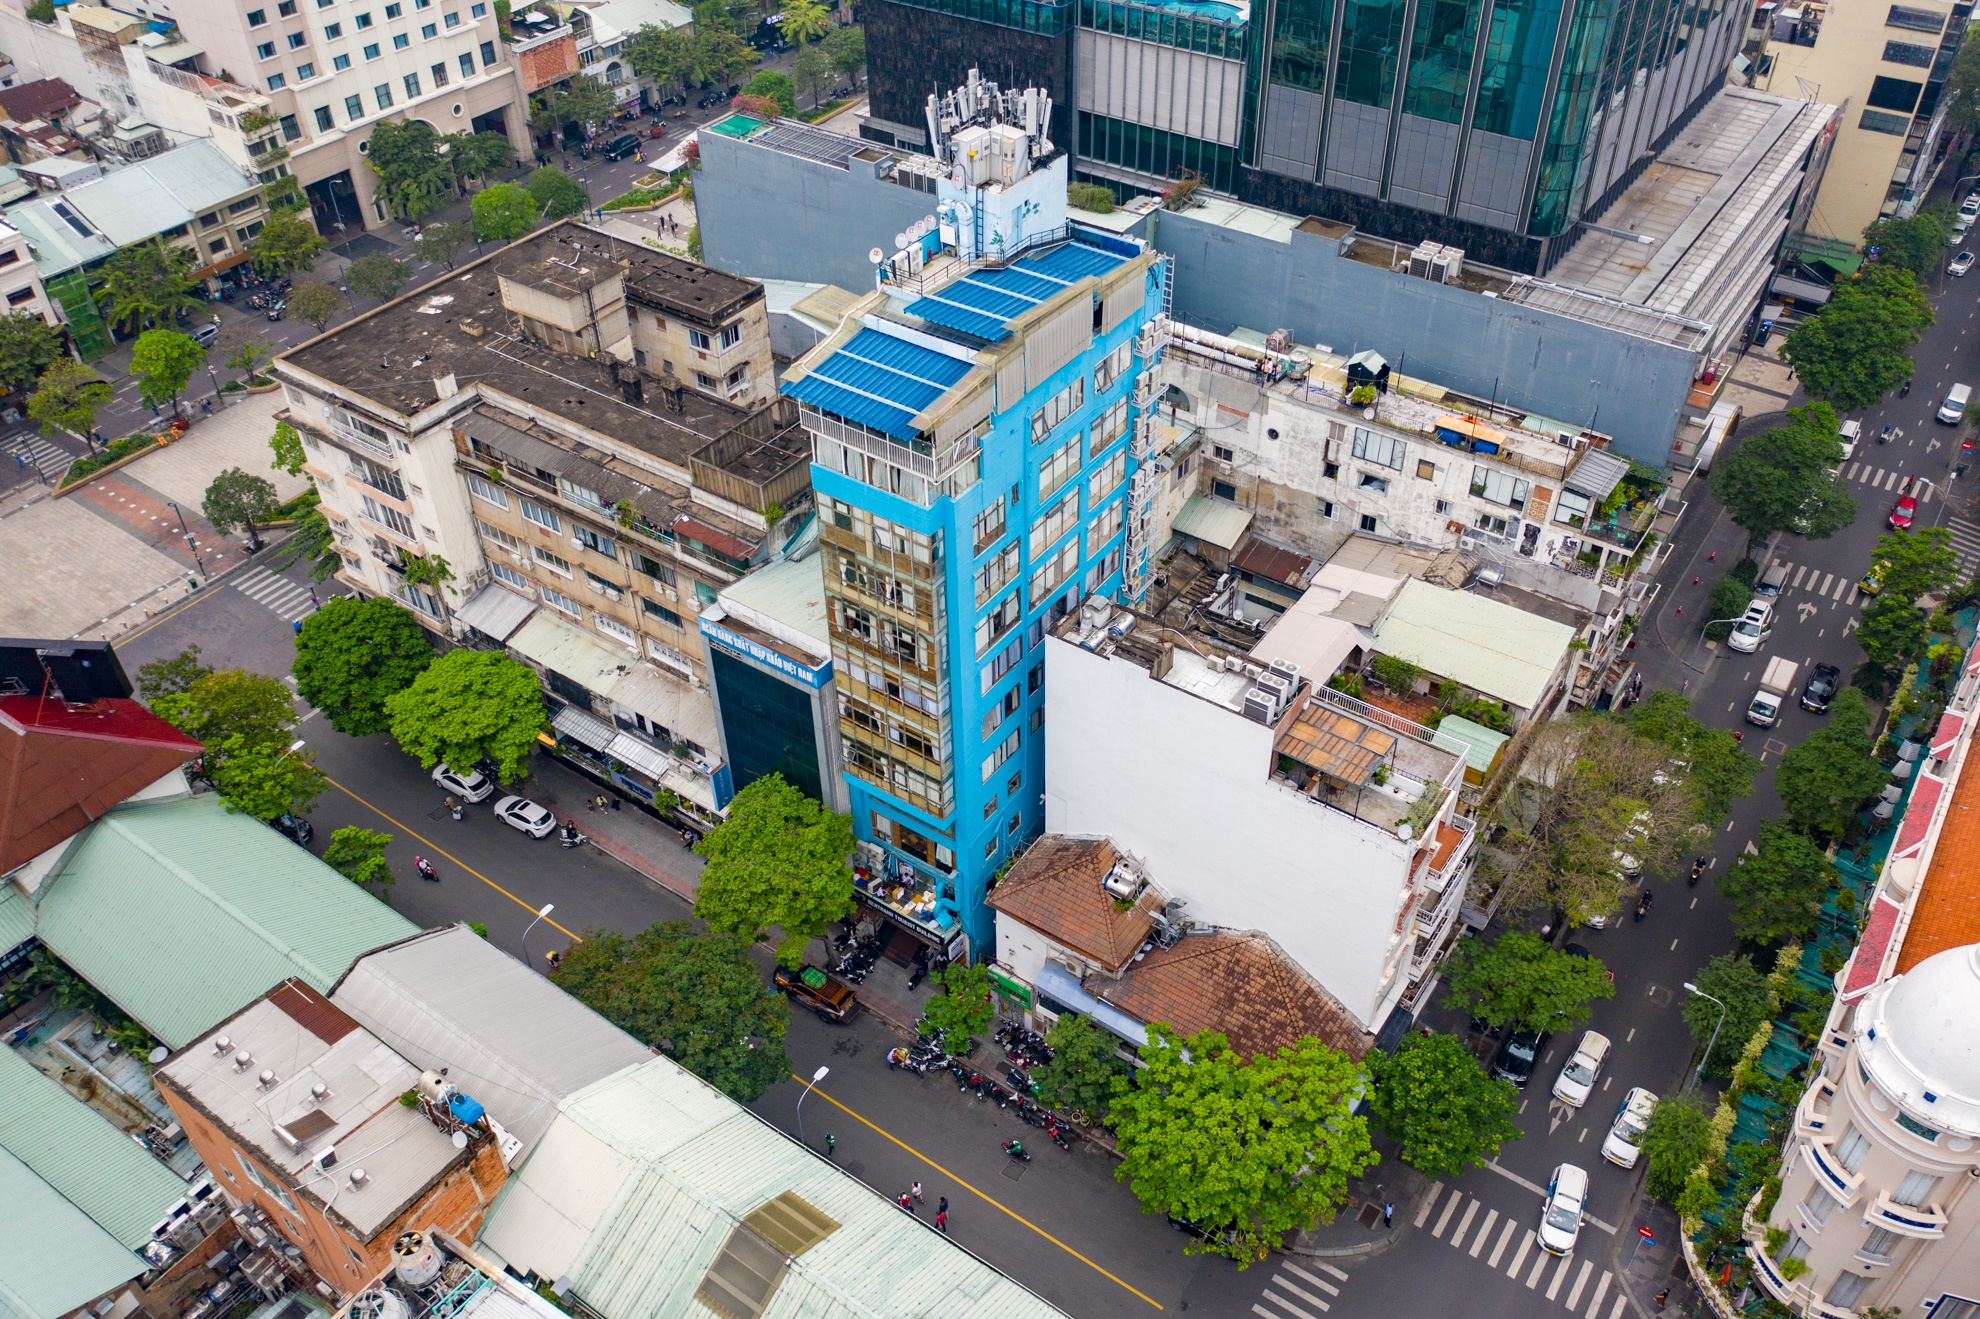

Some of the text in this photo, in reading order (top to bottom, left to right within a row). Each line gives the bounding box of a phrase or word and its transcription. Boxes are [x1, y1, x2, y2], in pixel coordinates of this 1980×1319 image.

[782, 660, 797, 676] VIỆT
[797, 667, 813, 683] NAM
[867, 899, 940, 943] BENTHANH TOURIST BUILDING
